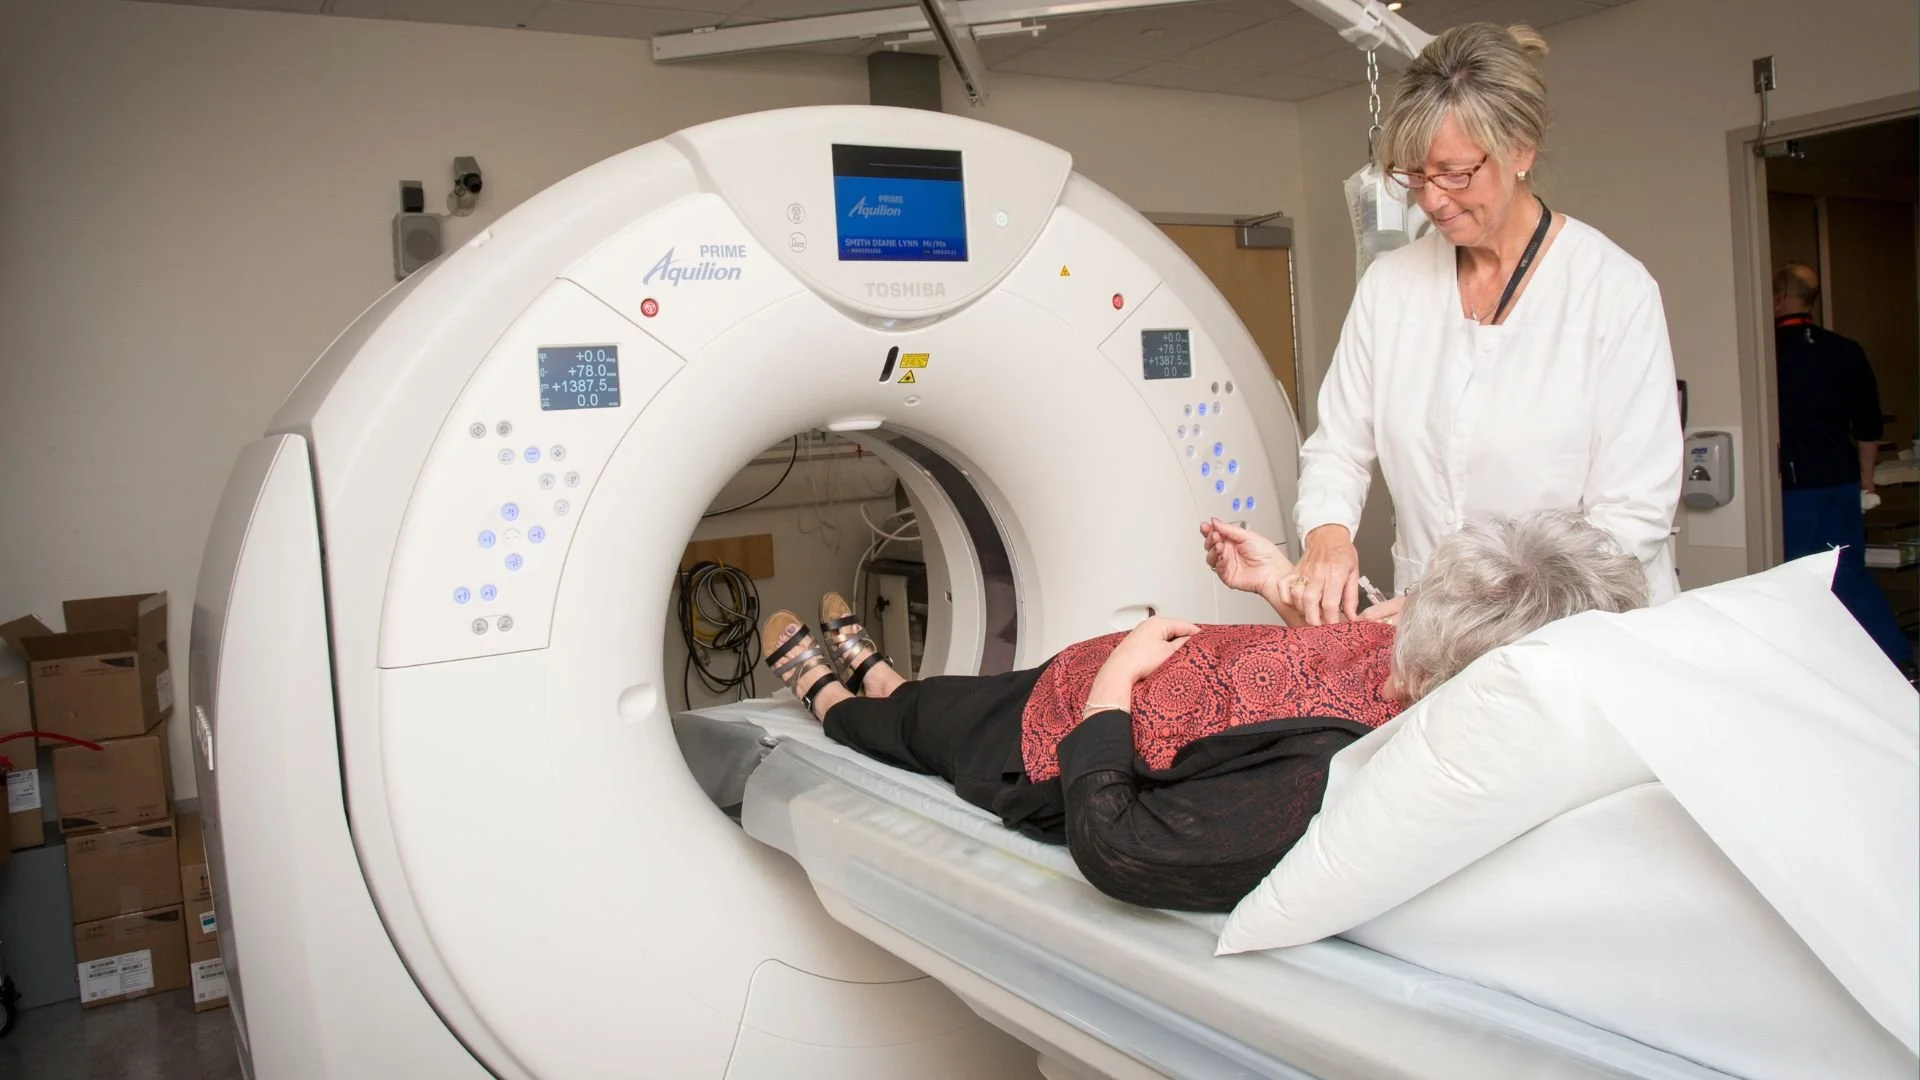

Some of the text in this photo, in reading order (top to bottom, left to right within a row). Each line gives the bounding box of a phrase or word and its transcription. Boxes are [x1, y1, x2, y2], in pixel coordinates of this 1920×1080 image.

[879, 195, 903, 204] PRIME
[848, 195, 902, 219] Aquilion
[845, 238, 871, 247] SMITH
[872, 239, 897, 247] DIANE
[700, 244, 747, 258] PRIME
[643, 246, 742, 287] Aquilion
[864, 281, 947, 298] TOSHIBA
[1163, 332, 1181, 343] +0.0
[576, 349, 606, 362] +0.0
[1158, 344, 1182, 354] +78.0
[1149, 355, 1182, 366] +1387.5
[568, 364, 607, 377] +78.0
[1164, 367, 1177, 377] 0.0
[552, 378, 608, 393] +1387.5
[577, 394, 598, 407] 0.0
